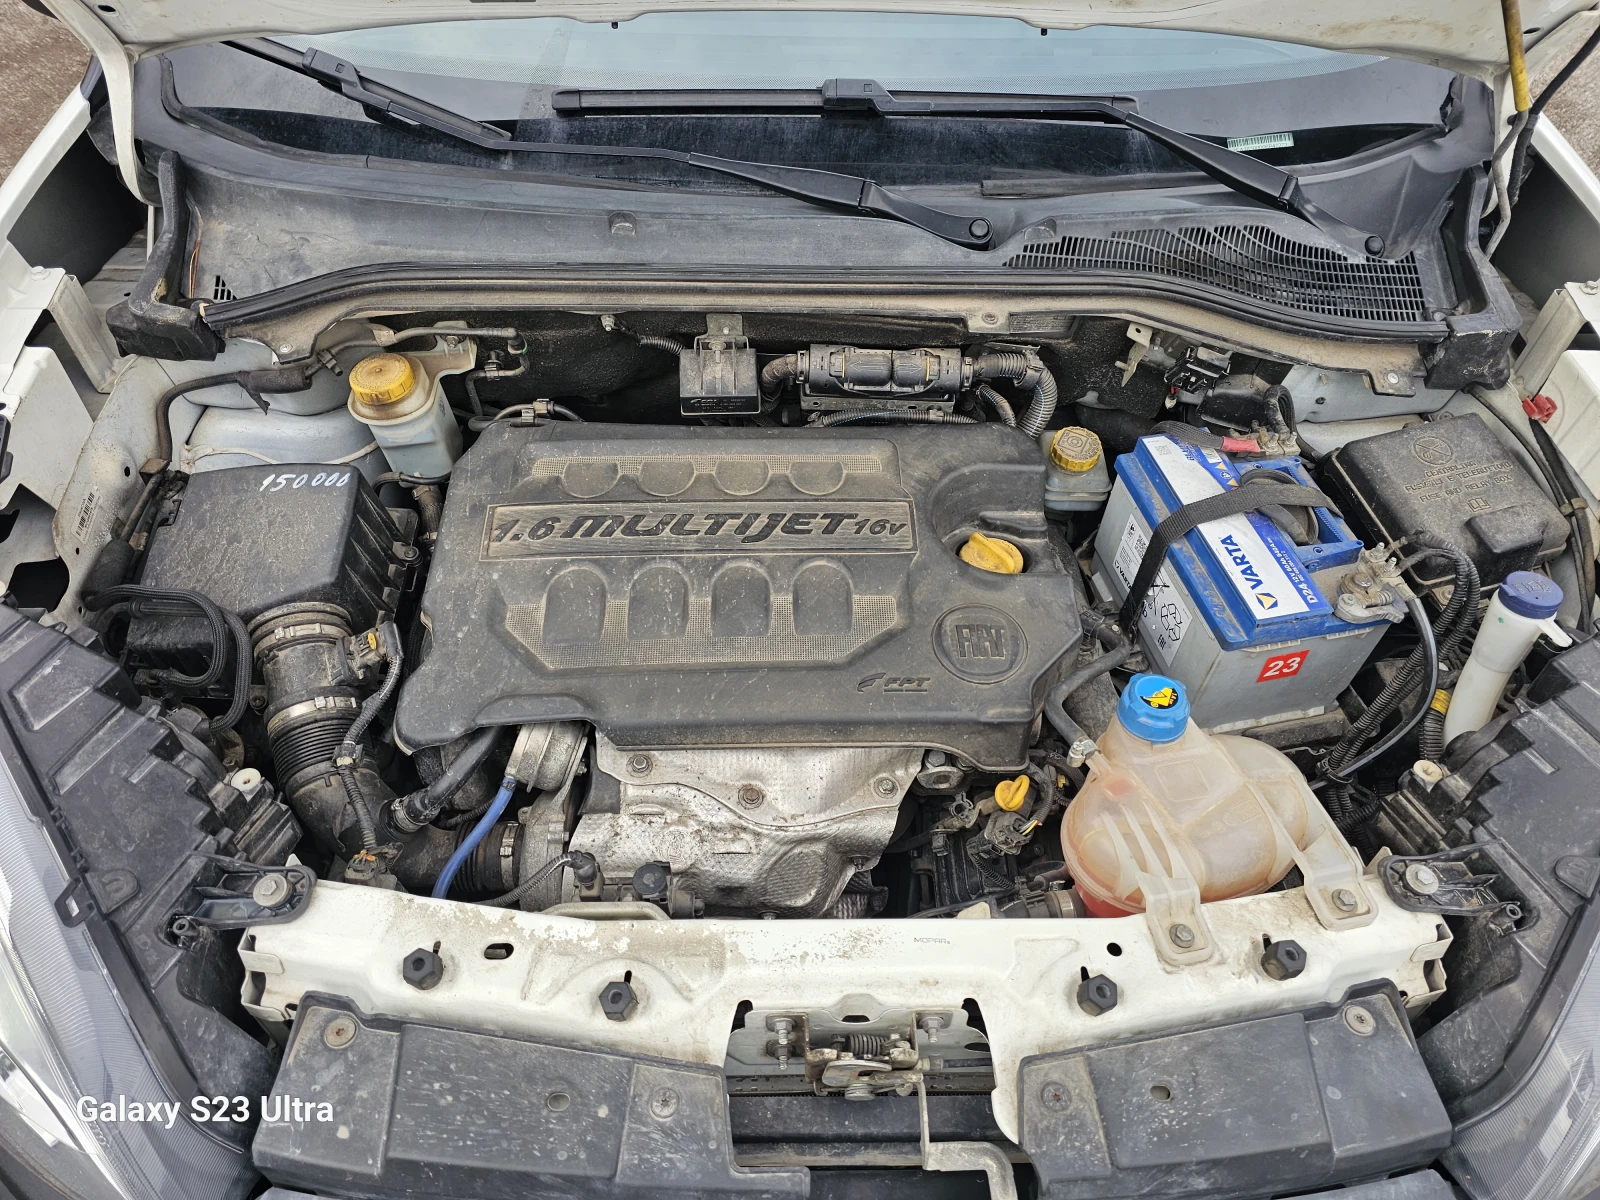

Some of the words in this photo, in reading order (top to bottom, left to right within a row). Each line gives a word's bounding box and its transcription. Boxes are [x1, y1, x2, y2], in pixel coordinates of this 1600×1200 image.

[1420, 491, 1443, 503] FUSE
[1445, 487, 1462, 497] AND
[1465, 478, 1492, 491] RELAY
[1494, 474, 1513, 484] BOX
[492, 517, 560, 543] 1.6
[560, 512, 859, 544] MULTIJET
[1220, 534, 1264, 590] VARTA
[1298, 583, 1318, 603] D24
[954, 623, 1005, 658] FIAT
[1263, 657, 1301, 677] 23
[883, 676, 931, 689] FPT
